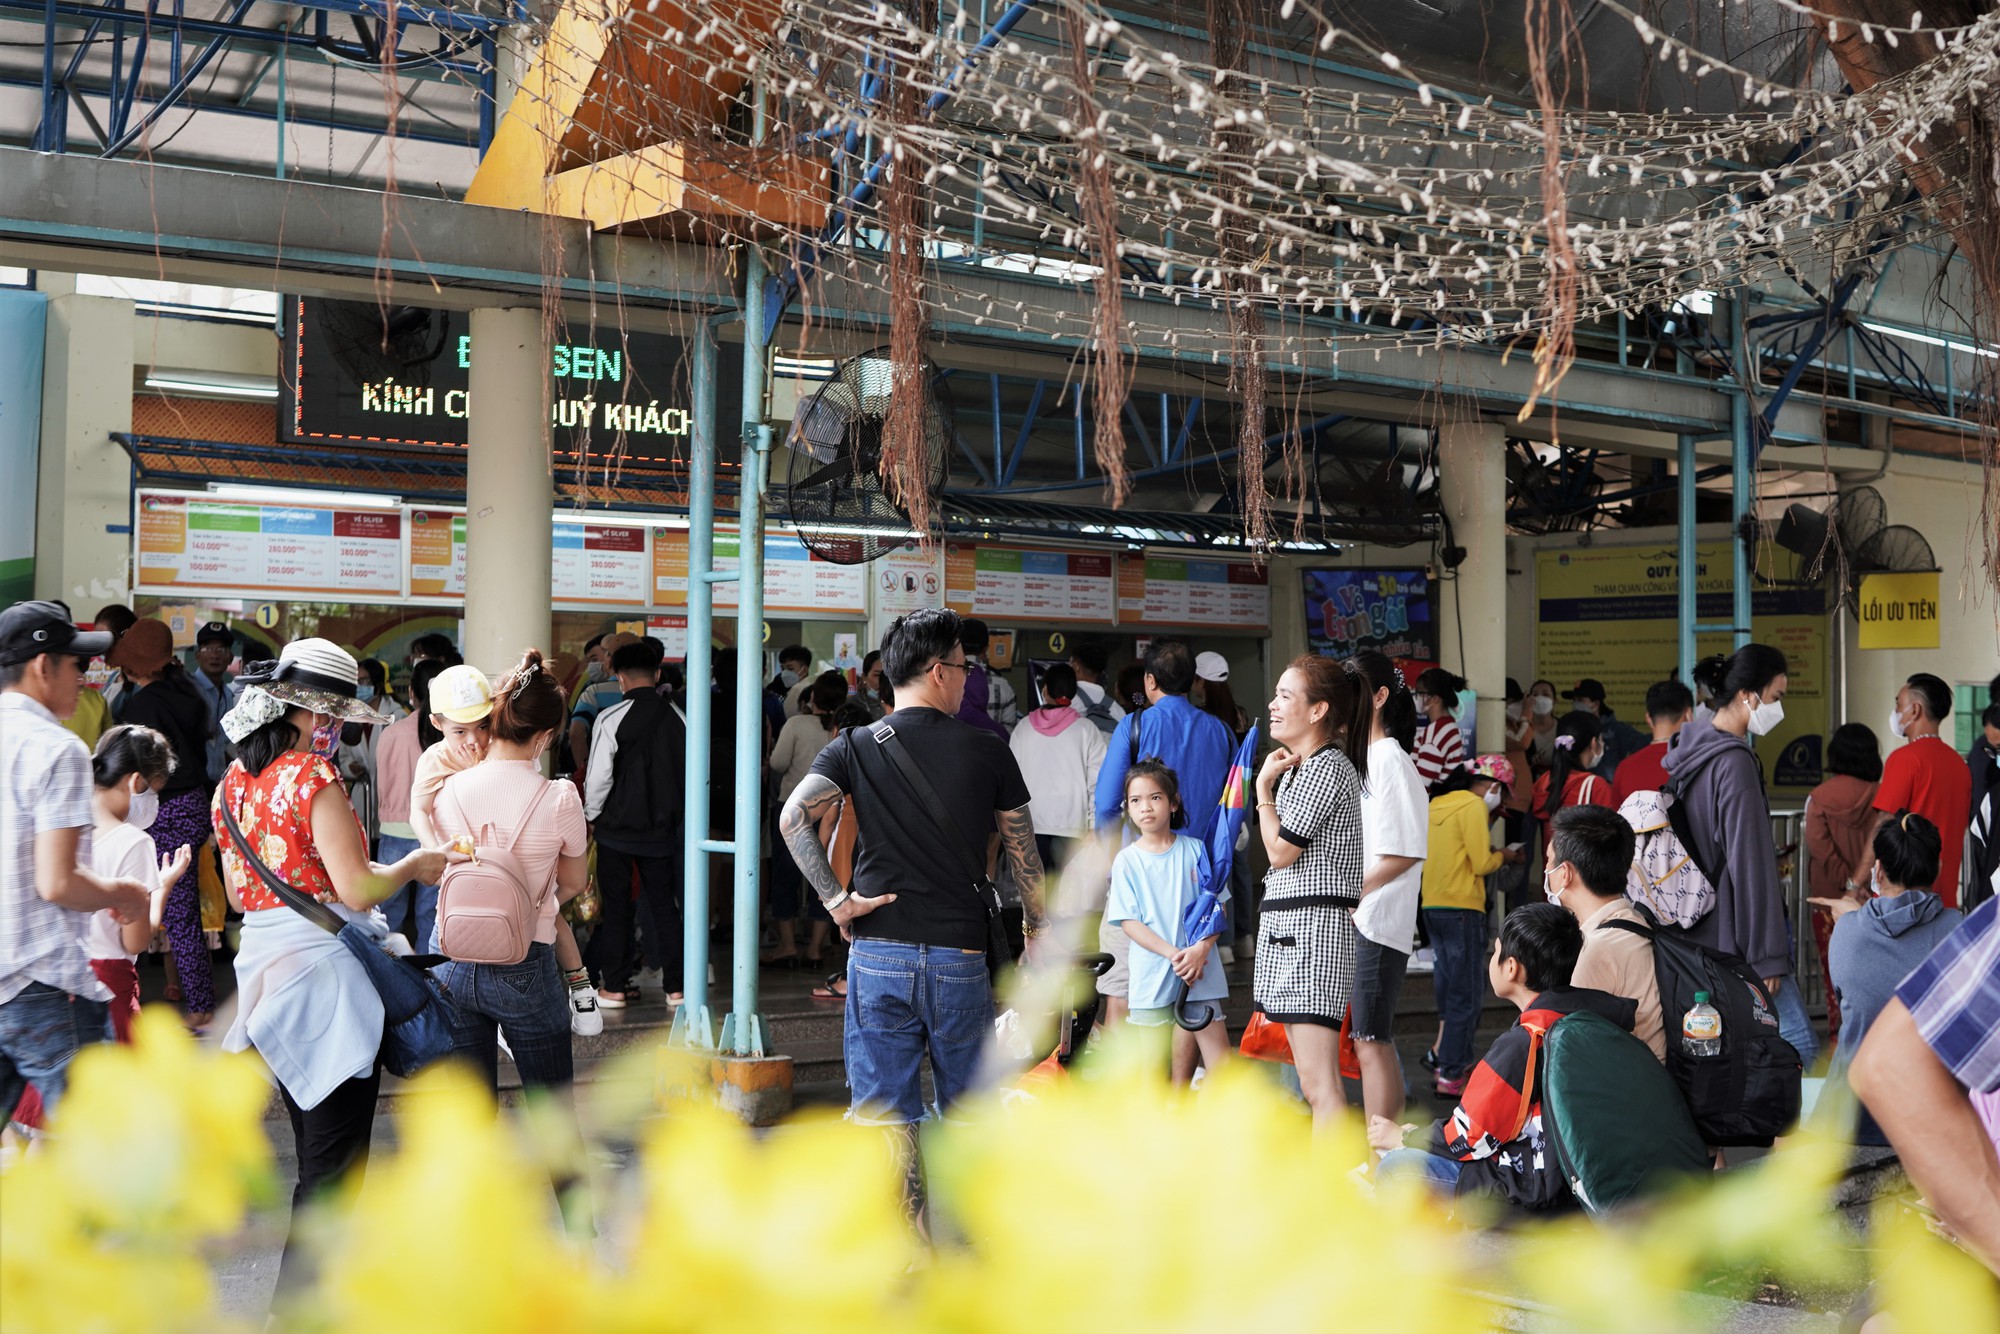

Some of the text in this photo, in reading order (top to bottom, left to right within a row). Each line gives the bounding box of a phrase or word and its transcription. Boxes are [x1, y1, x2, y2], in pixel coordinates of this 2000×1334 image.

[362, 376, 434, 417] KÍNH
[553, 393, 597, 429] UÝ
[1647, 565, 1672, 578] QUY
[1378, 575, 1397, 597] 30
[1593, 584, 1617, 594] THAM
[1618, 583, 1641, 595] QUAN
[1337, 583, 1365, 613] Vé
[1863, 597, 1936, 621] LỐI ƯU TIÊN
[261, 606, 270, 625] 1
[1052, 634, 1062, 651] 4
